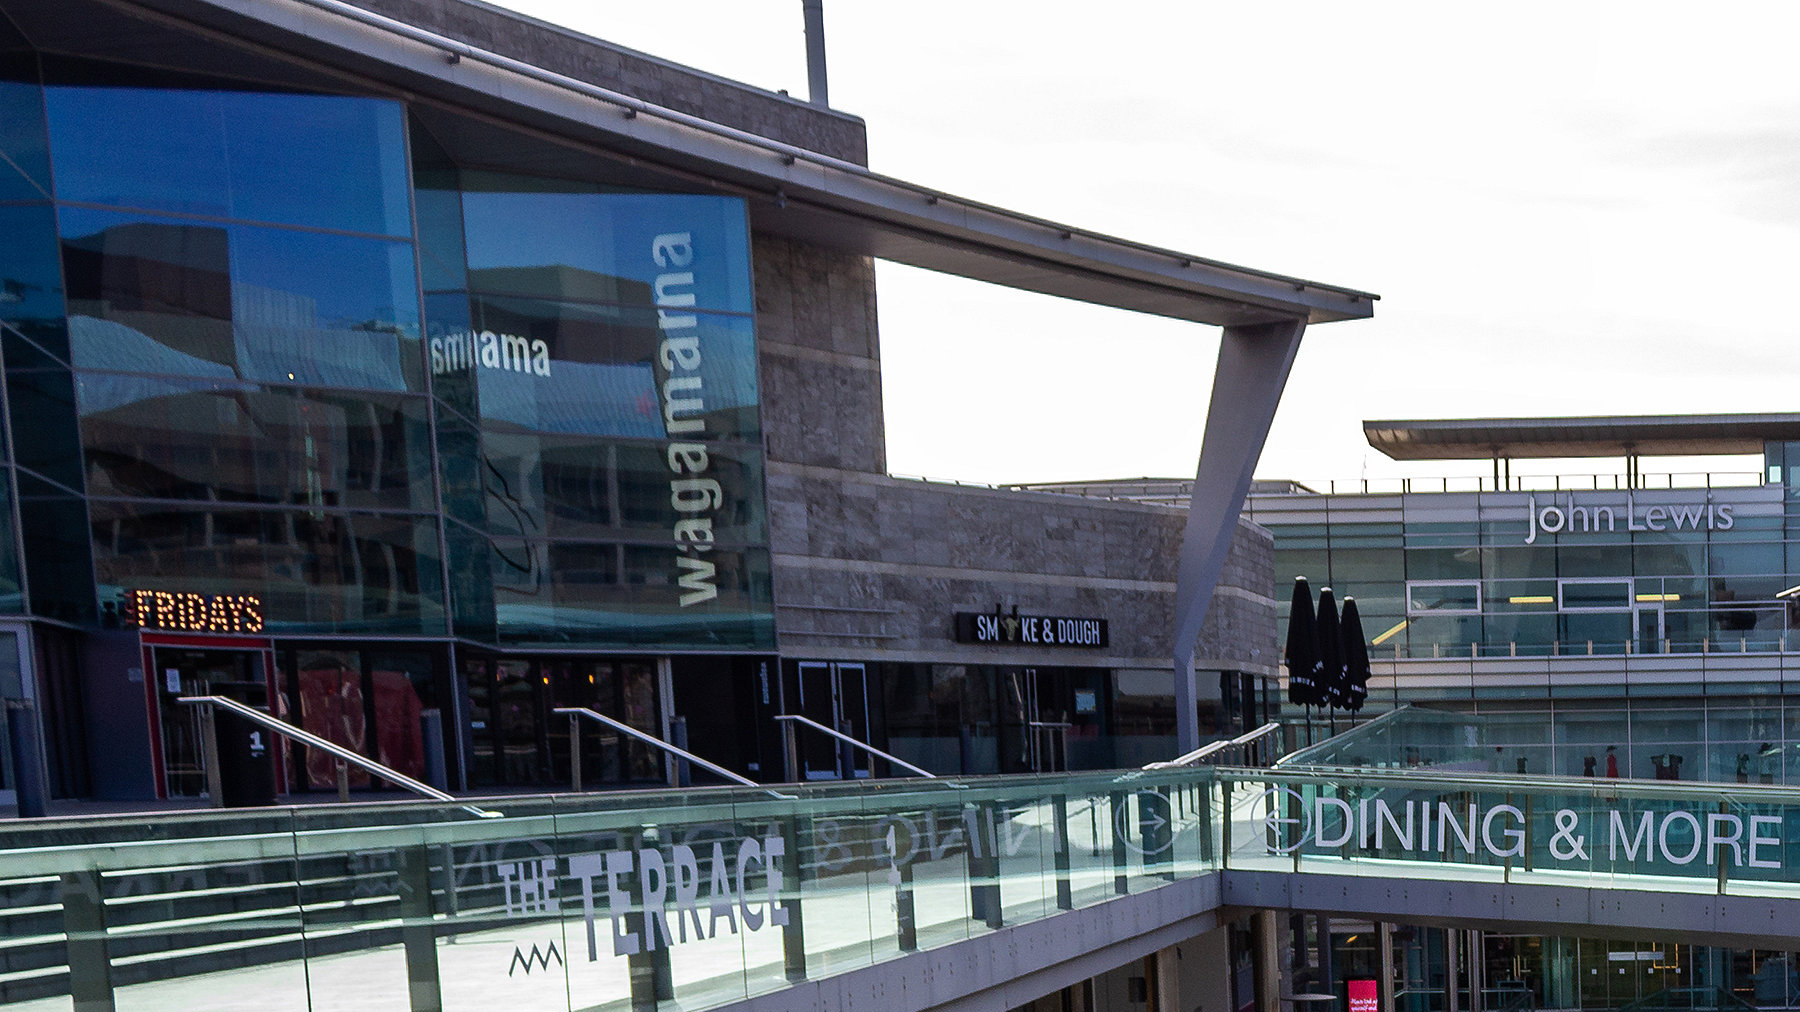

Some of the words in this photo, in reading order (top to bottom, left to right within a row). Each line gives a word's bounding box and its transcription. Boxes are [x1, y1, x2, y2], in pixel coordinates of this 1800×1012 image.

[653, 231, 722, 607] wagamama
[1525, 496, 1614, 544] John
[1628, 494, 1734, 531] Lewis
[136, 589, 263, 632] FRIDAYS
[977, 615, 1039, 642] SMKE
[1043, 617, 1054, 643] &
[1058, 619, 1100, 645] DOUGH
[1315, 797, 1526, 857] DINING
[1550, 809, 1589, 861] &
[1609, 810, 1783, 869] MORE
[498, 859, 560, 918] THE
[569, 837, 790, 962] TERRACE
